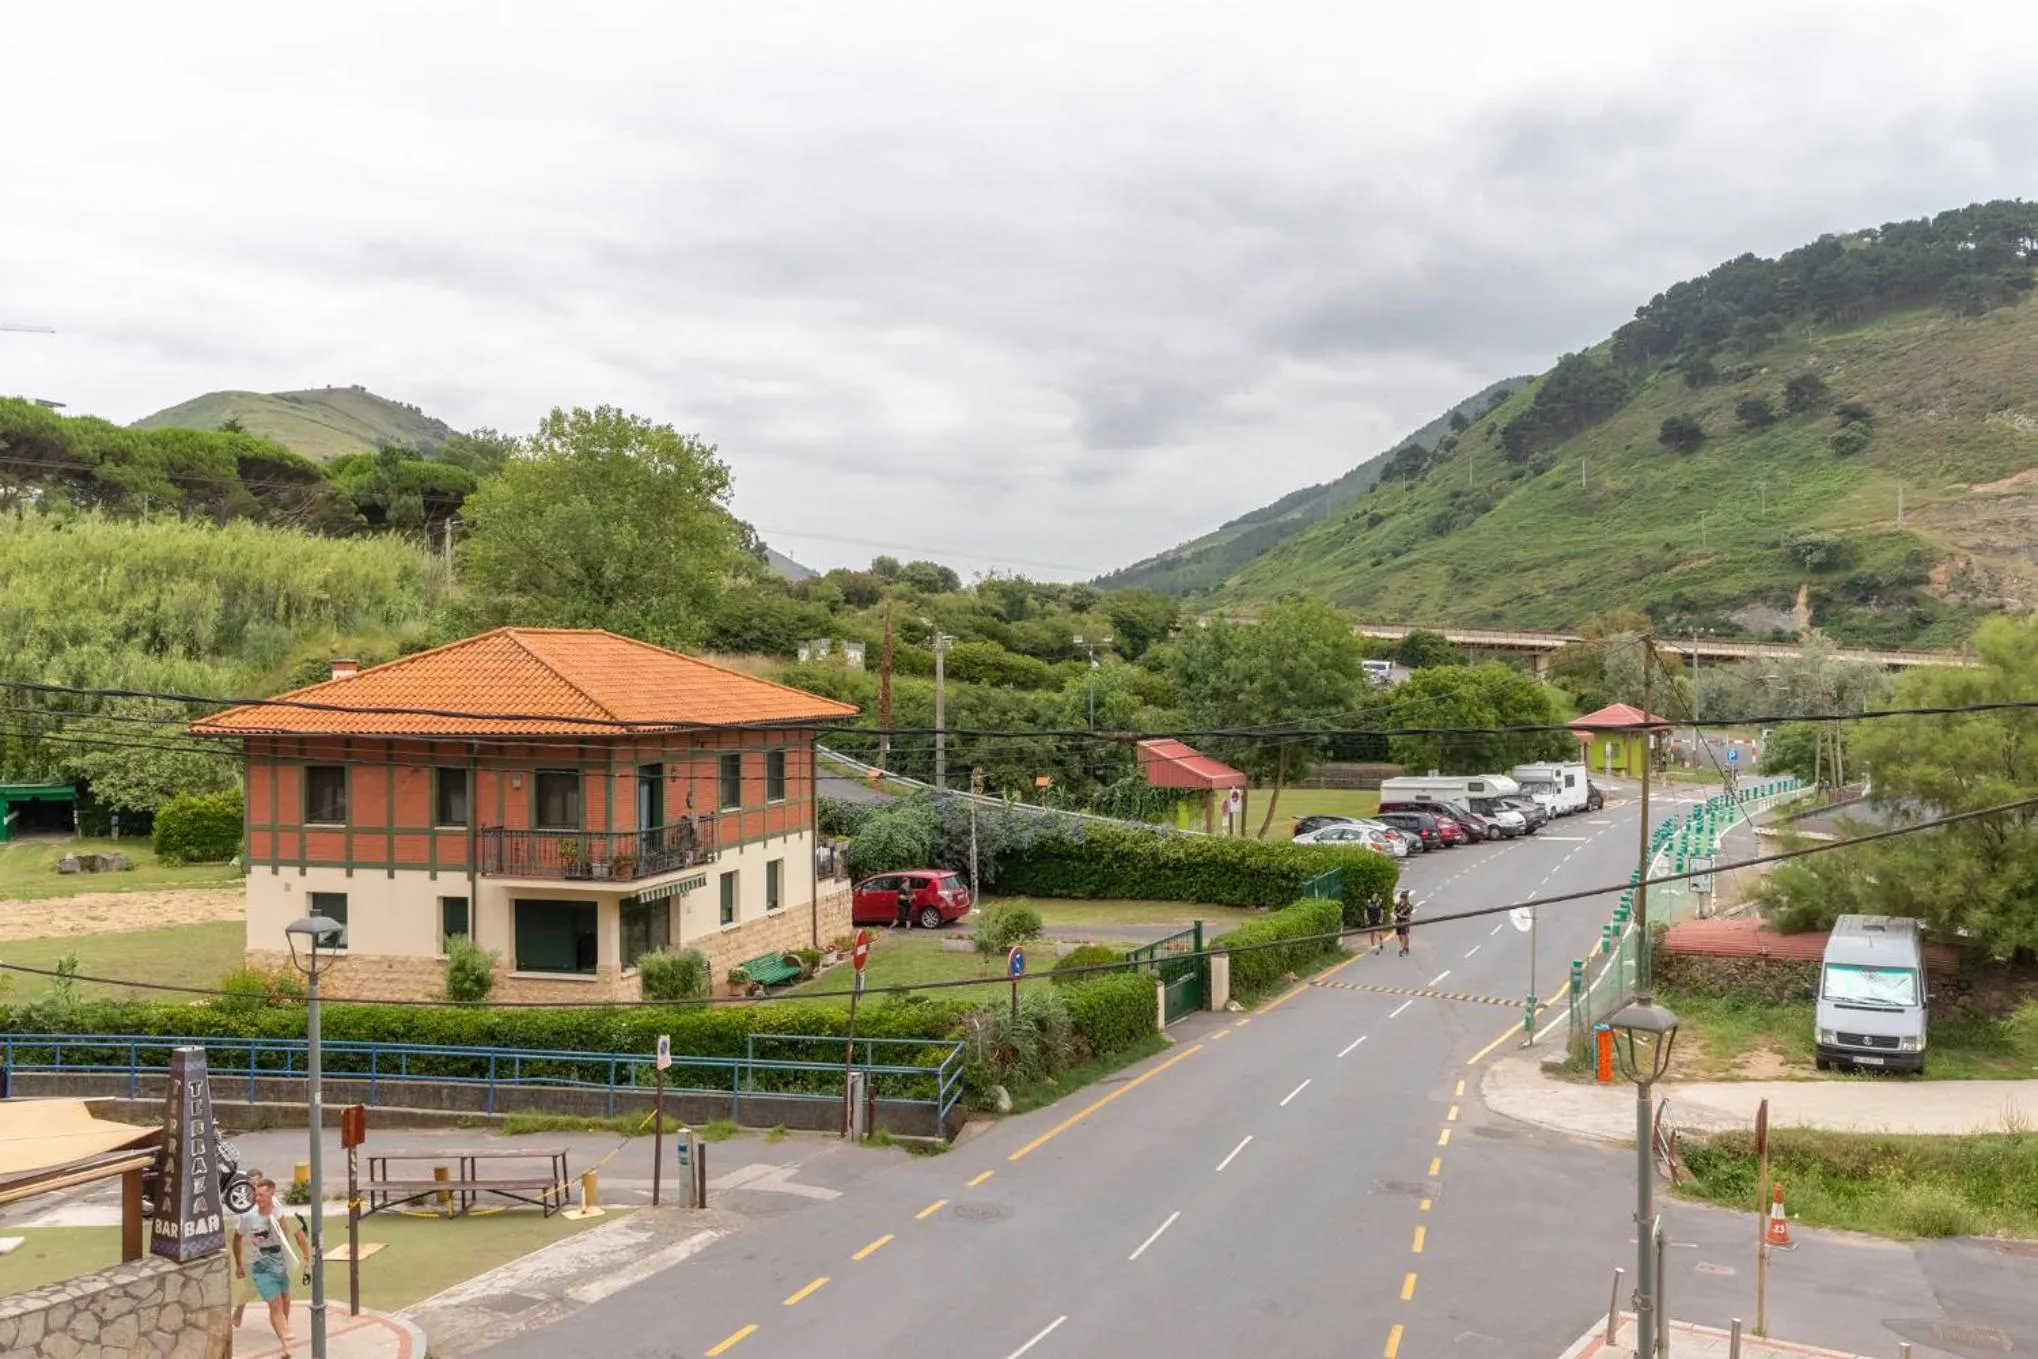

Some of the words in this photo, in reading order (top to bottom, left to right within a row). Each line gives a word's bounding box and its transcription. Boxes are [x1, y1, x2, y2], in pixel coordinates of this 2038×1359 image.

[188, 1080, 208, 1214] TERRAZA
[154, 1219, 178, 1238] BAR
[184, 1214, 219, 1237] BAR
